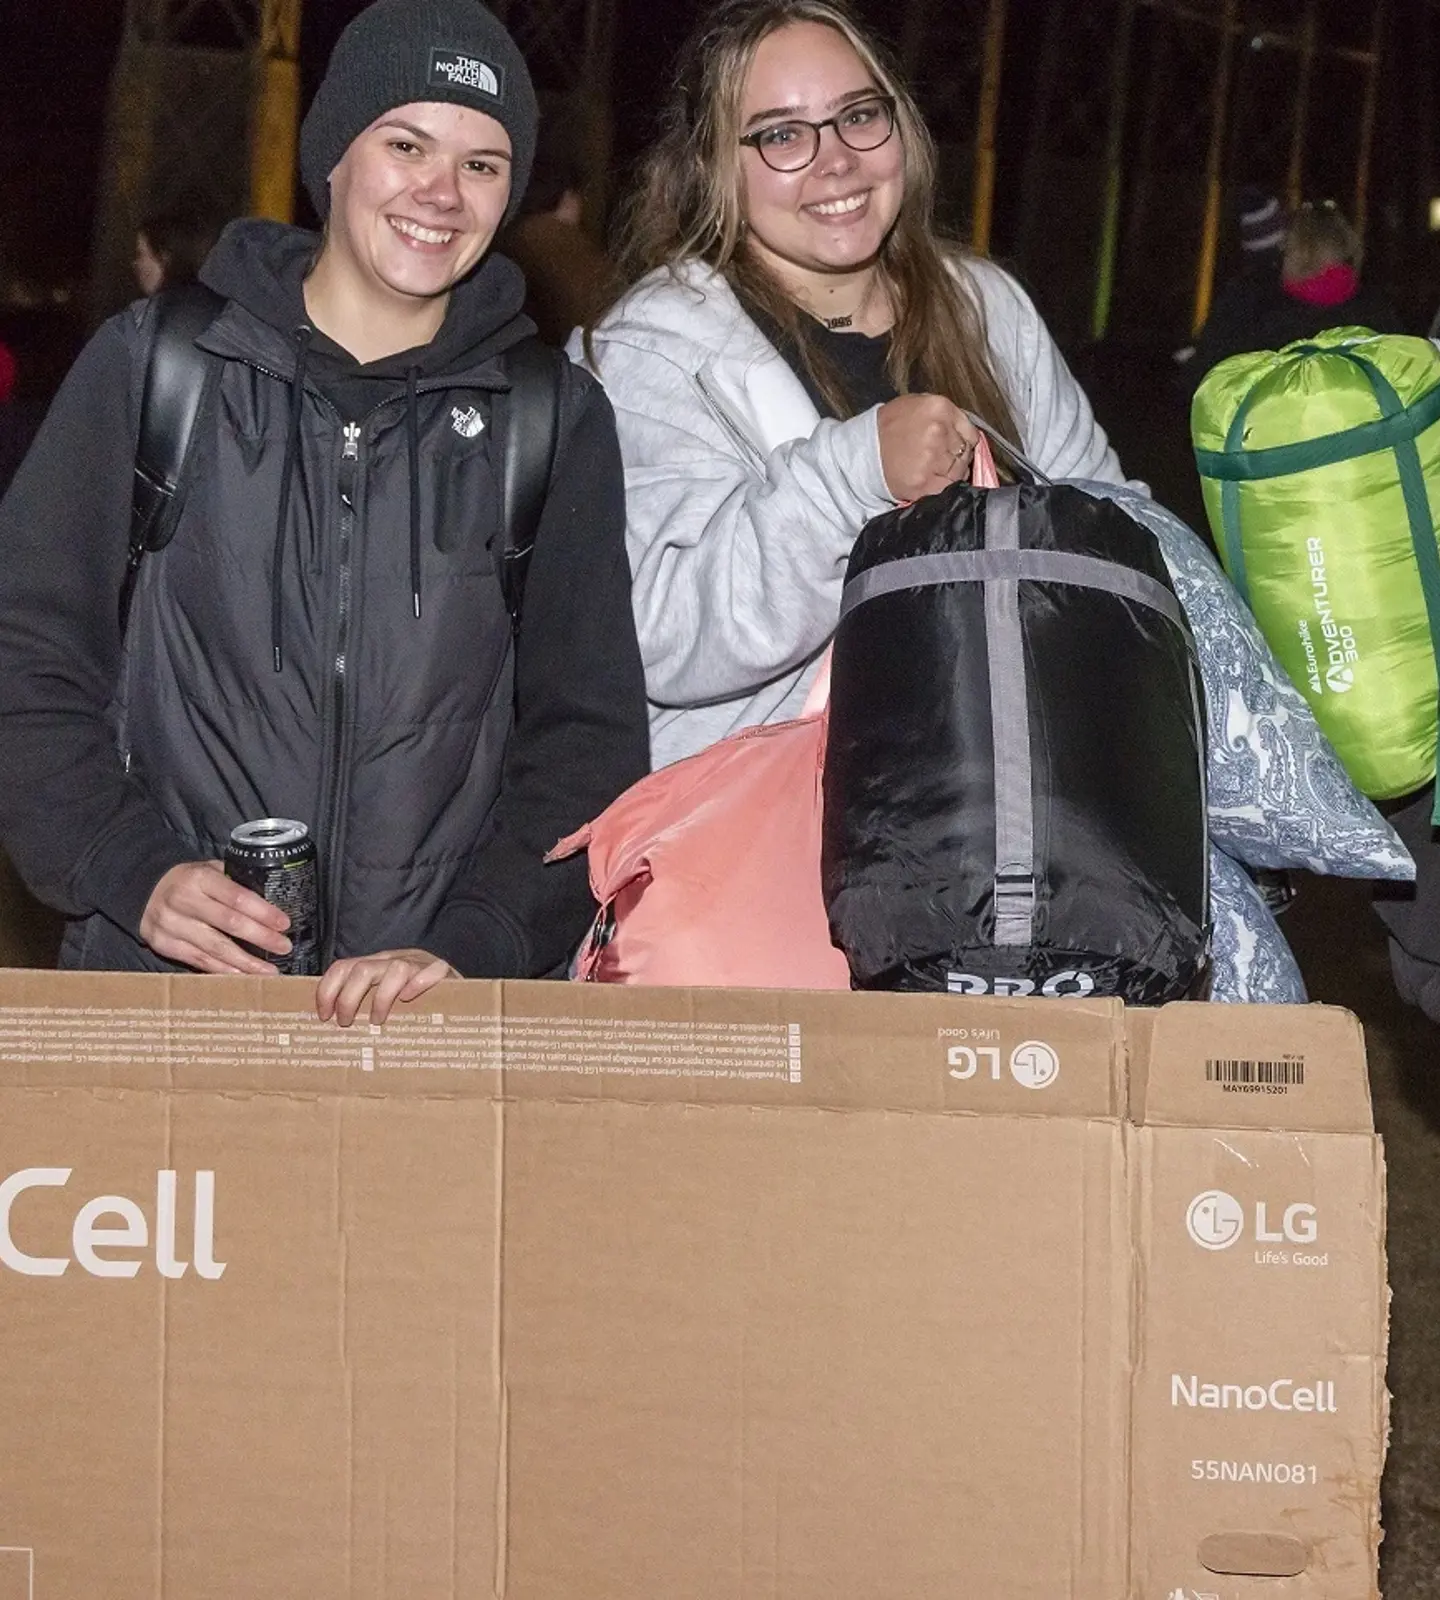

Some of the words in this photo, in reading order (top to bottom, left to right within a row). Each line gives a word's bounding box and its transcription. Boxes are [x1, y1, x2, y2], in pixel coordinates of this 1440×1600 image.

[435, 61, 479, 79] NORTH
[456, 56, 480, 67] THE
[447, 72, 478, 87] FACE
[1298, 620, 1318, 673] Eurohike
[1339, 625, 1359, 663] 300
[938, 1028, 969, 1042] Good
[971, 1028, 1000, 1040] Life's
[948, 1046, 1000, 1080] LG
[1255, 1201, 1318, 1243] LG
[1254, 1251, 1289, 1264] Life's
[1292, 1252, 1329, 1266] Good
[1171, 1373, 1338, 1413] NanoCell
[1190, 1459, 1319, 1485] 55NANO81
